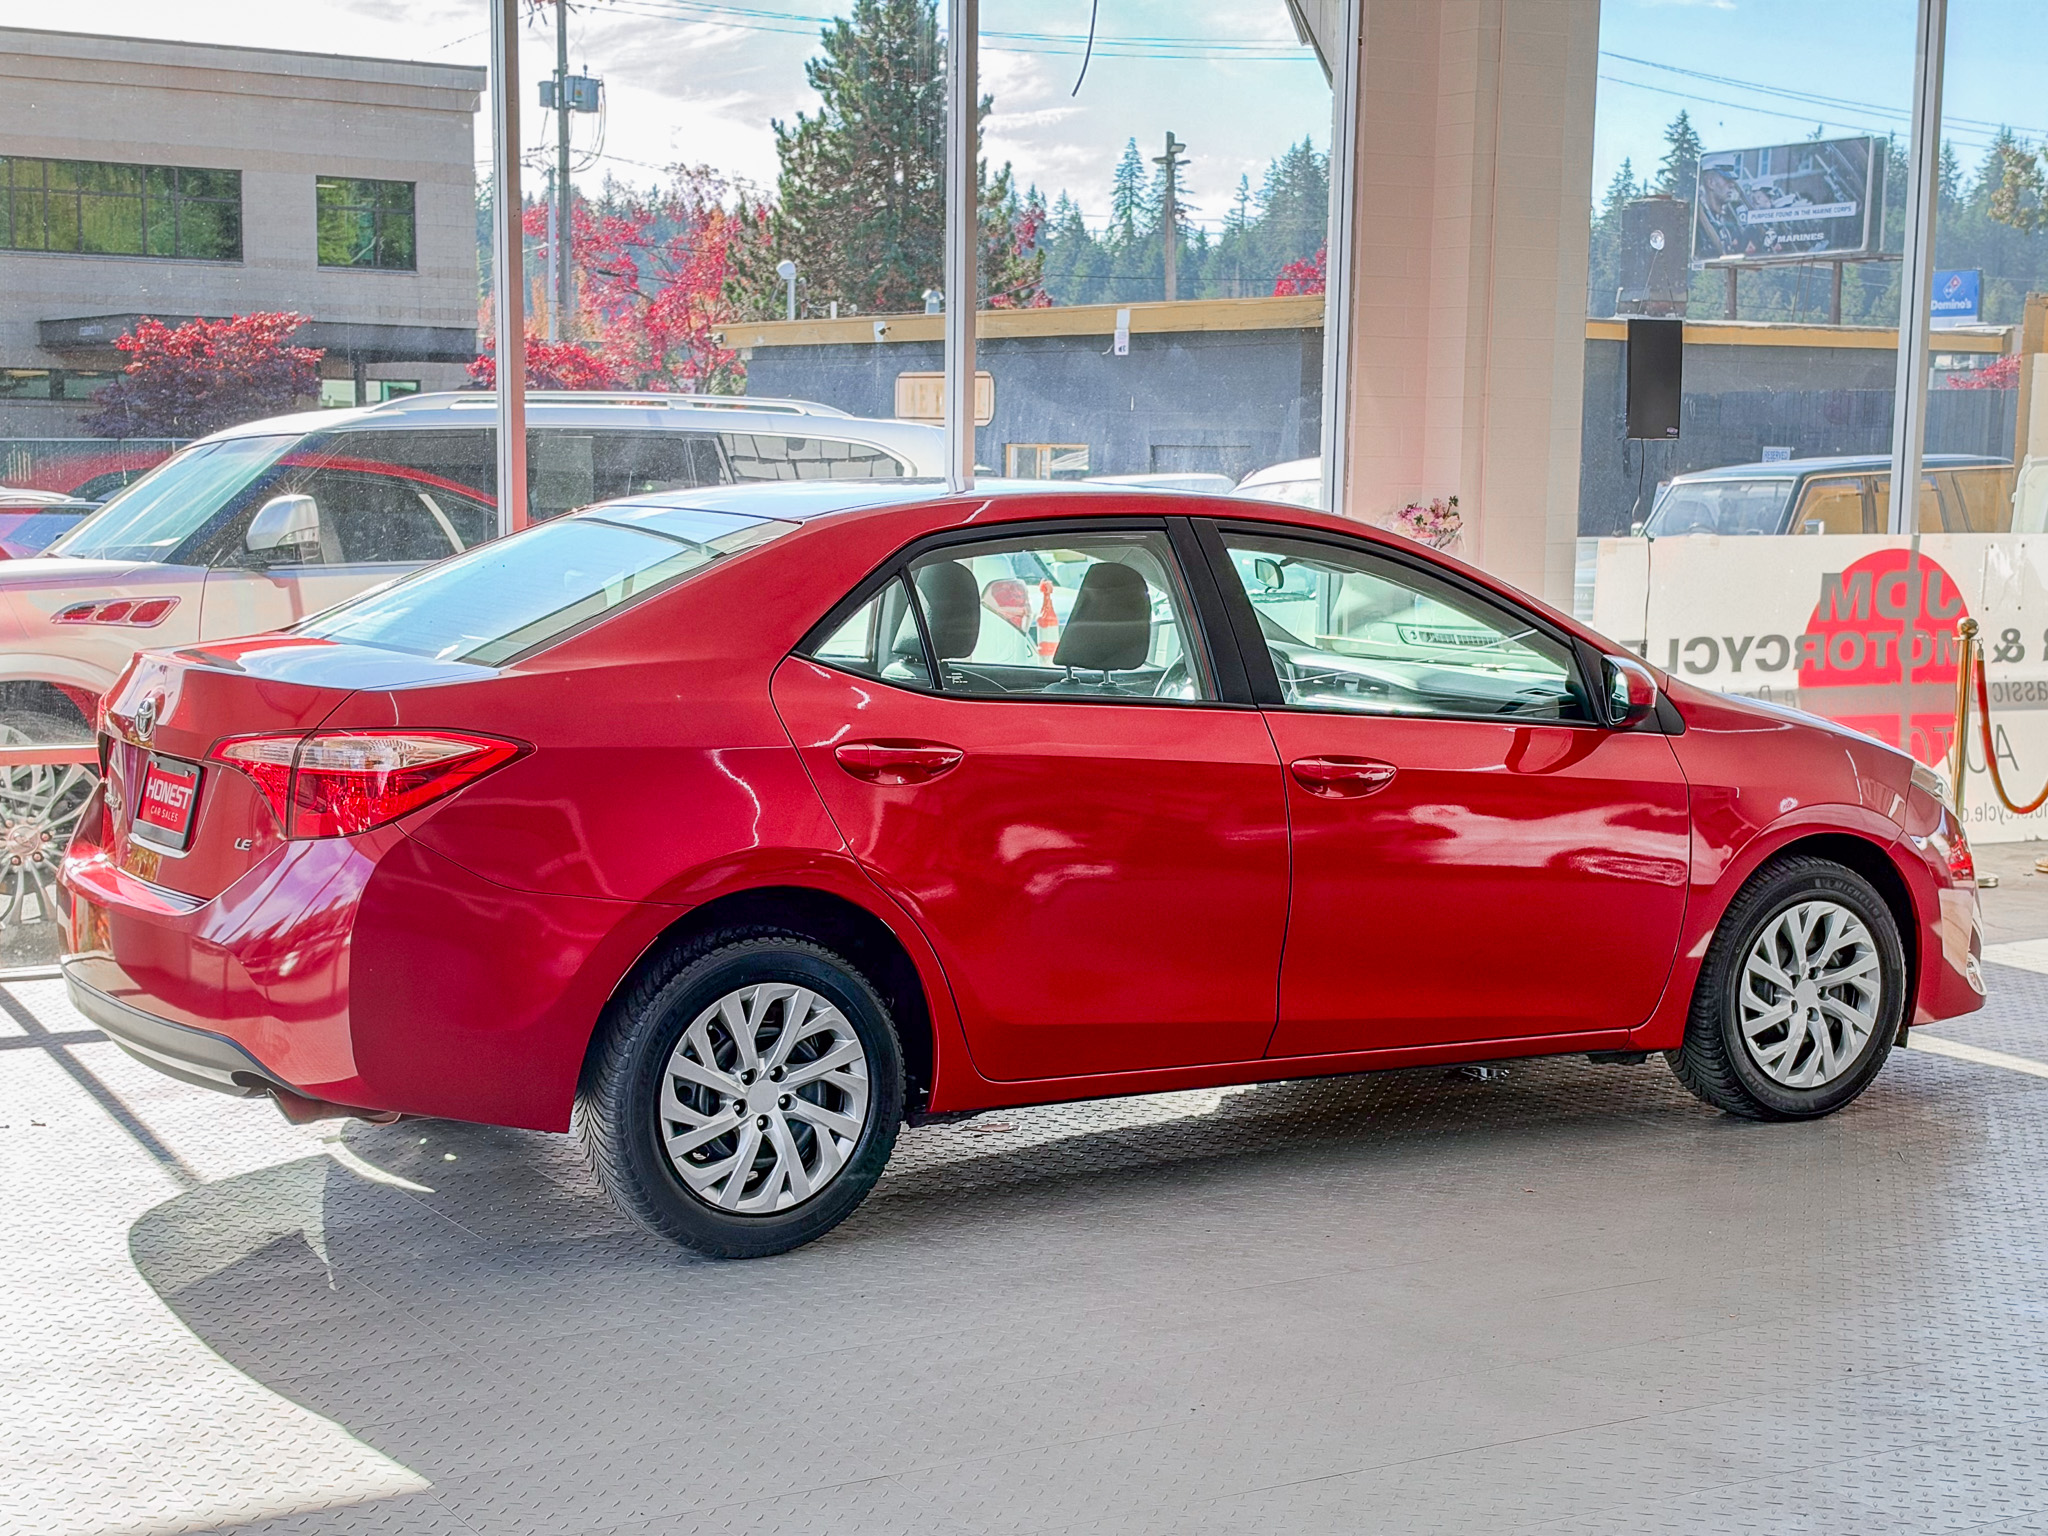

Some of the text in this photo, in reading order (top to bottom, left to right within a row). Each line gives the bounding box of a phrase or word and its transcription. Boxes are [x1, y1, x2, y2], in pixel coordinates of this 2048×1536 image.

[1751, 211, 1774, 220] PURPOSE
[1775, 210, 1793, 218] FOUND
[1801, 208, 1812, 216] THE
[1812, 207, 1832, 215] MARINE
[1833, 205, 1852, 214] CORPS
[1777, 232, 1825, 243] MARINES
[1931, 298, 1972, 311] Domino's
[146, 776, 193, 810] HONEST
[150, 805, 179, 823] CAR SALES
[234, 837, 253, 851] LE
